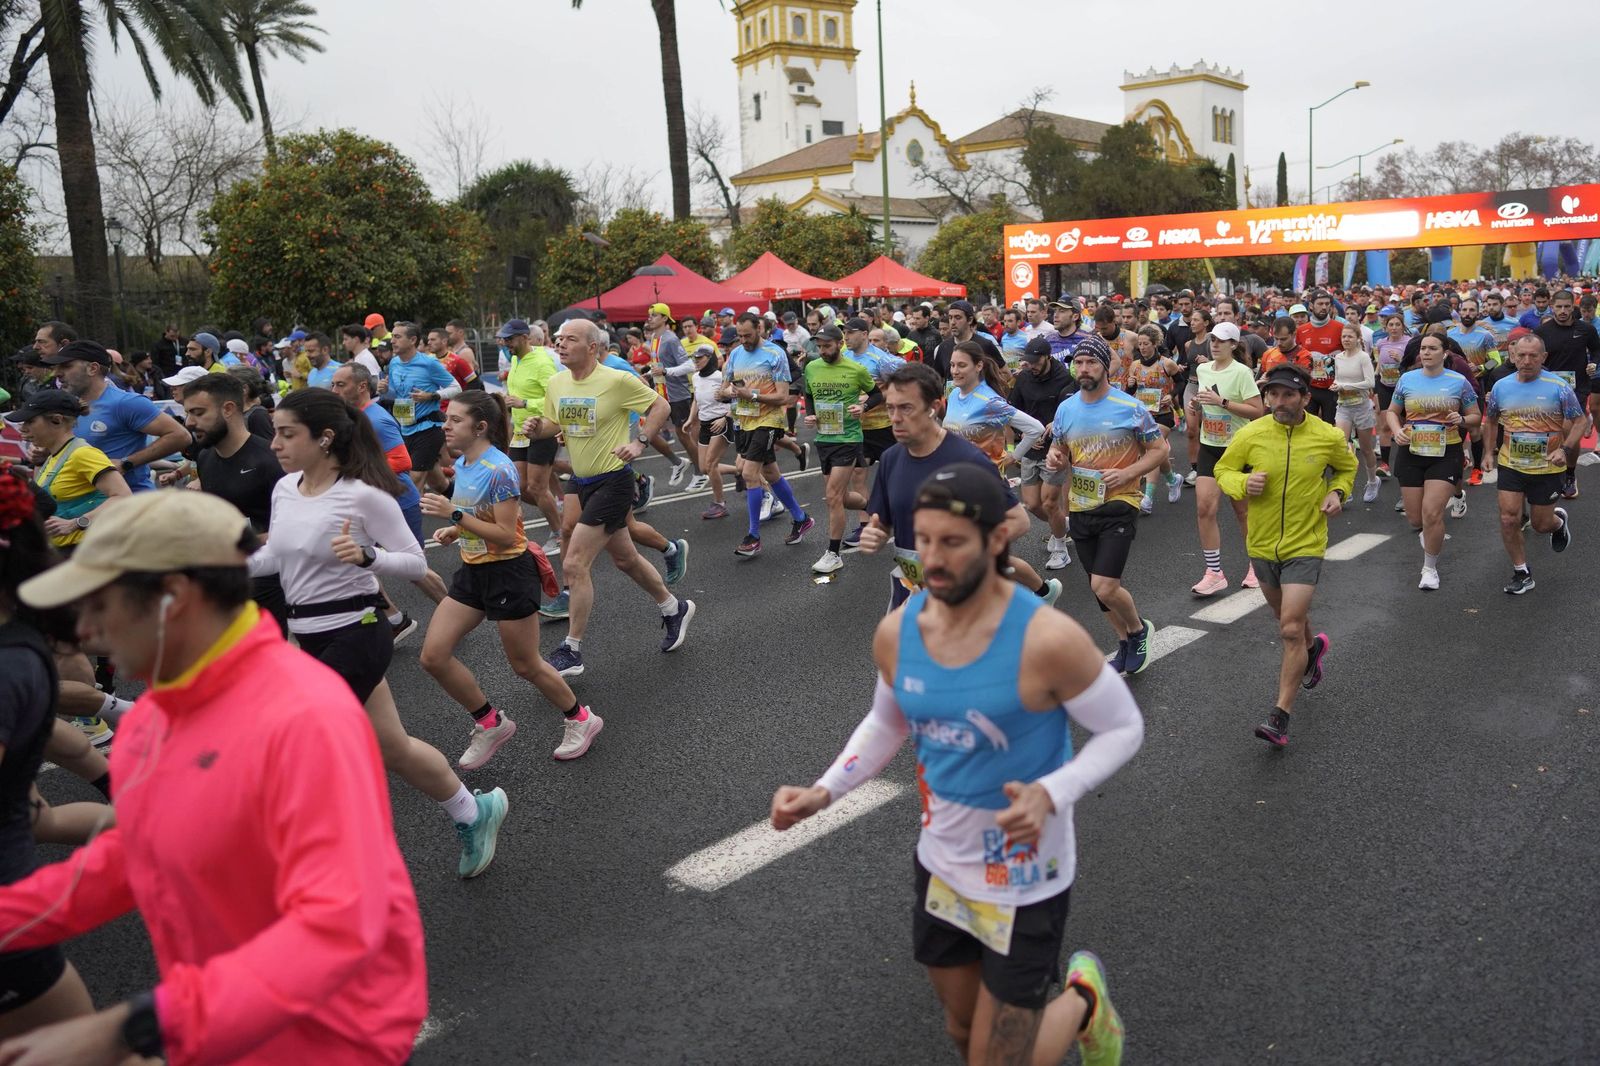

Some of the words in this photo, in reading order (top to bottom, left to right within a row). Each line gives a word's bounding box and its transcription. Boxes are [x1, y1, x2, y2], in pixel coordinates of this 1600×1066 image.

[1425, 210, 1482, 229] HOKA
[560, 406, 590, 420] 12947
[1512, 443, 1542, 455] 10554
[1072, 476, 1096, 493] 9359
